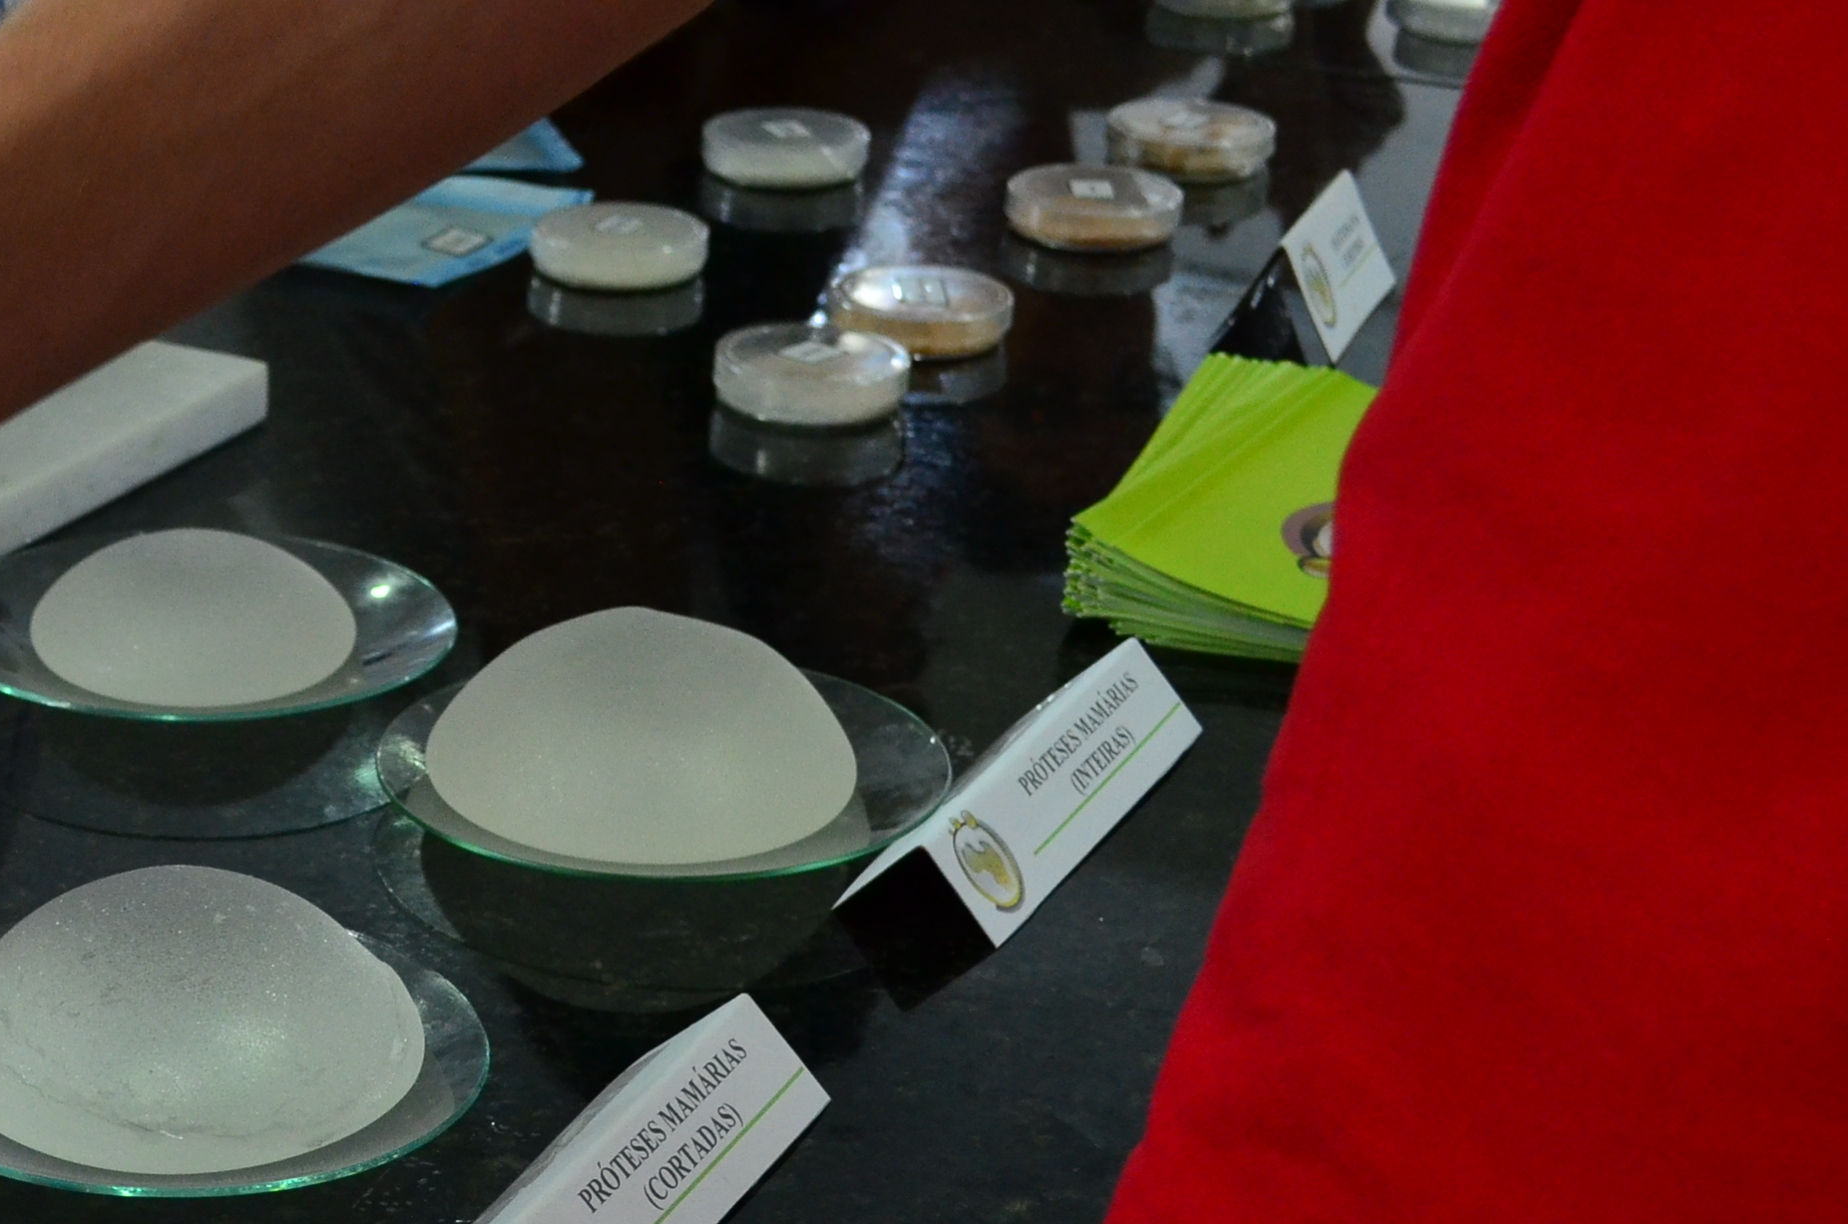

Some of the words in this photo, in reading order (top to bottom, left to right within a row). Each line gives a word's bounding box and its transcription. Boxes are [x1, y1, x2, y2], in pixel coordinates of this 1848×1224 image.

[1018, 729, 1082, 797] PRÓTESES
[1073, 672, 1139, 740] MAMÁRIAS
[1070, 725, 1136, 796] (INTEIRAS)
[577, 1120, 667, 1213] PRÓTESES
[657, 1038, 747, 1132] MAMÁRIAS
[643, 1103, 744, 1211] (CORTADAS)
